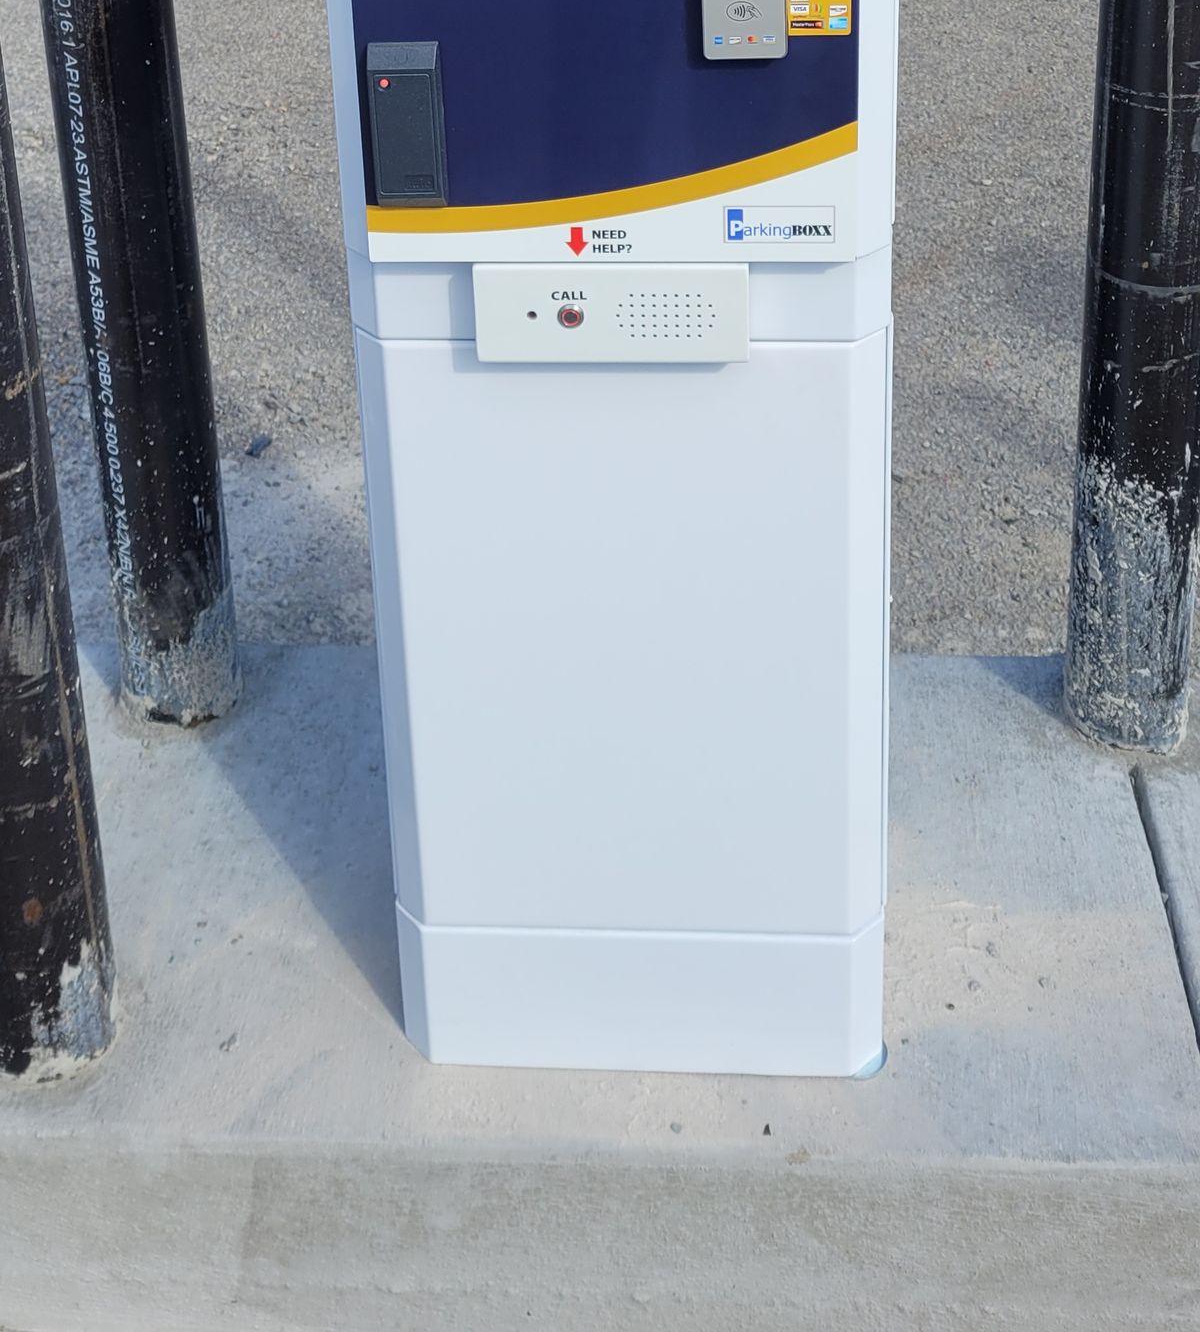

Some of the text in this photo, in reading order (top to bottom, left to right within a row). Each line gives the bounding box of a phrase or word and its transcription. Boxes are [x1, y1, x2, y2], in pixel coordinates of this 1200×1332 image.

[73, 147, 100, 269] ASTM/ASME
[592, 230, 627, 239] NEED
[592, 244, 633, 254] HELP?
[551, 291, 587, 300] CALL
